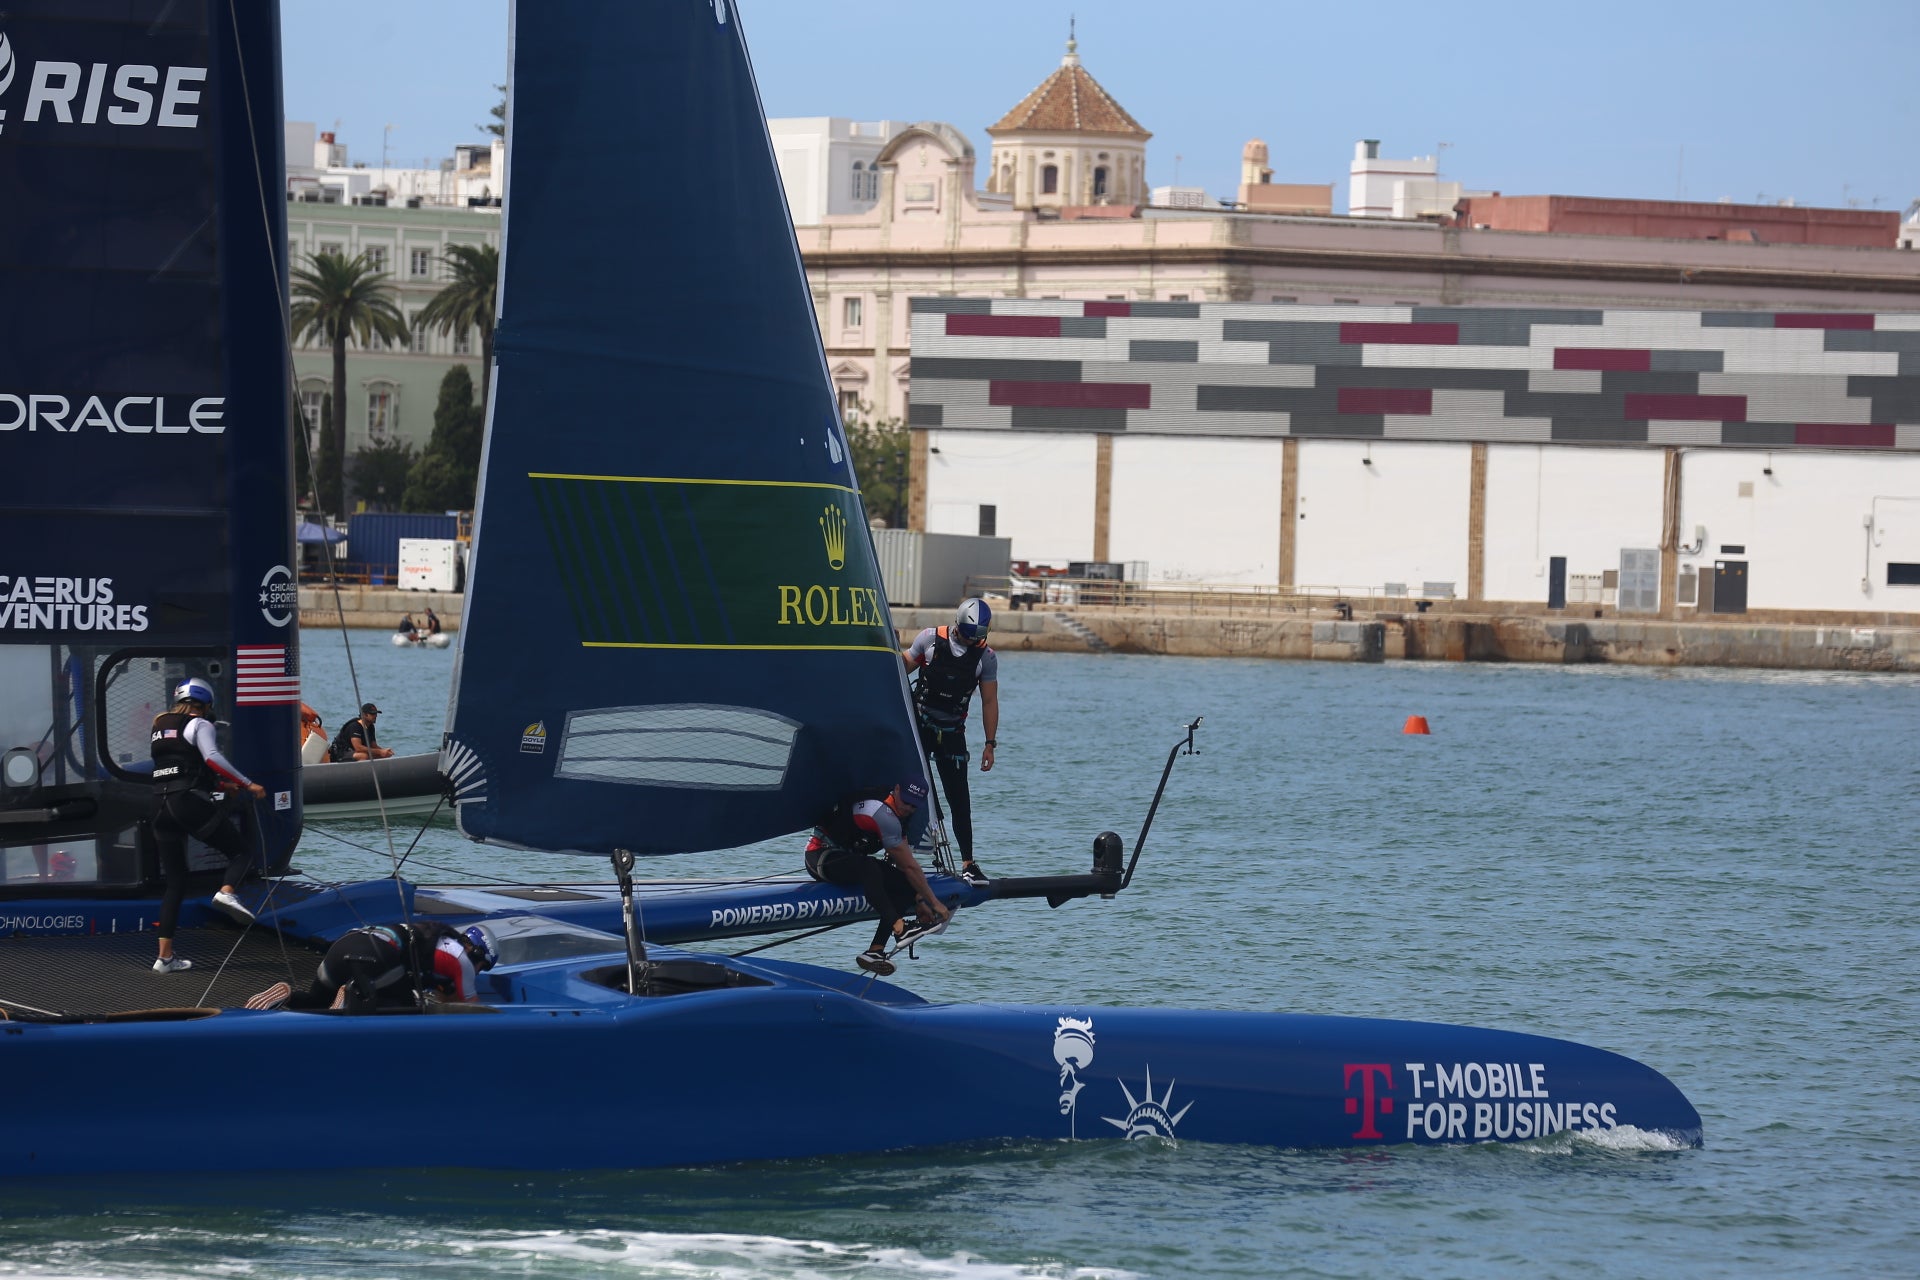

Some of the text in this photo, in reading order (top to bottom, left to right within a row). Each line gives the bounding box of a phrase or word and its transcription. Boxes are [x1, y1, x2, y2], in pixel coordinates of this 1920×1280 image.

[24, 60, 208, 128] RISE
[777, 584, 885, 627] ROLEX
[151, 730, 163, 742] SA
[709, 903, 795, 928] POWERED
[795, 900, 819, 919] BY
[1405, 1062, 1549, 1098] T-MOBILE
[1406, 1102, 1618, 1139] FOR BUSINESS
